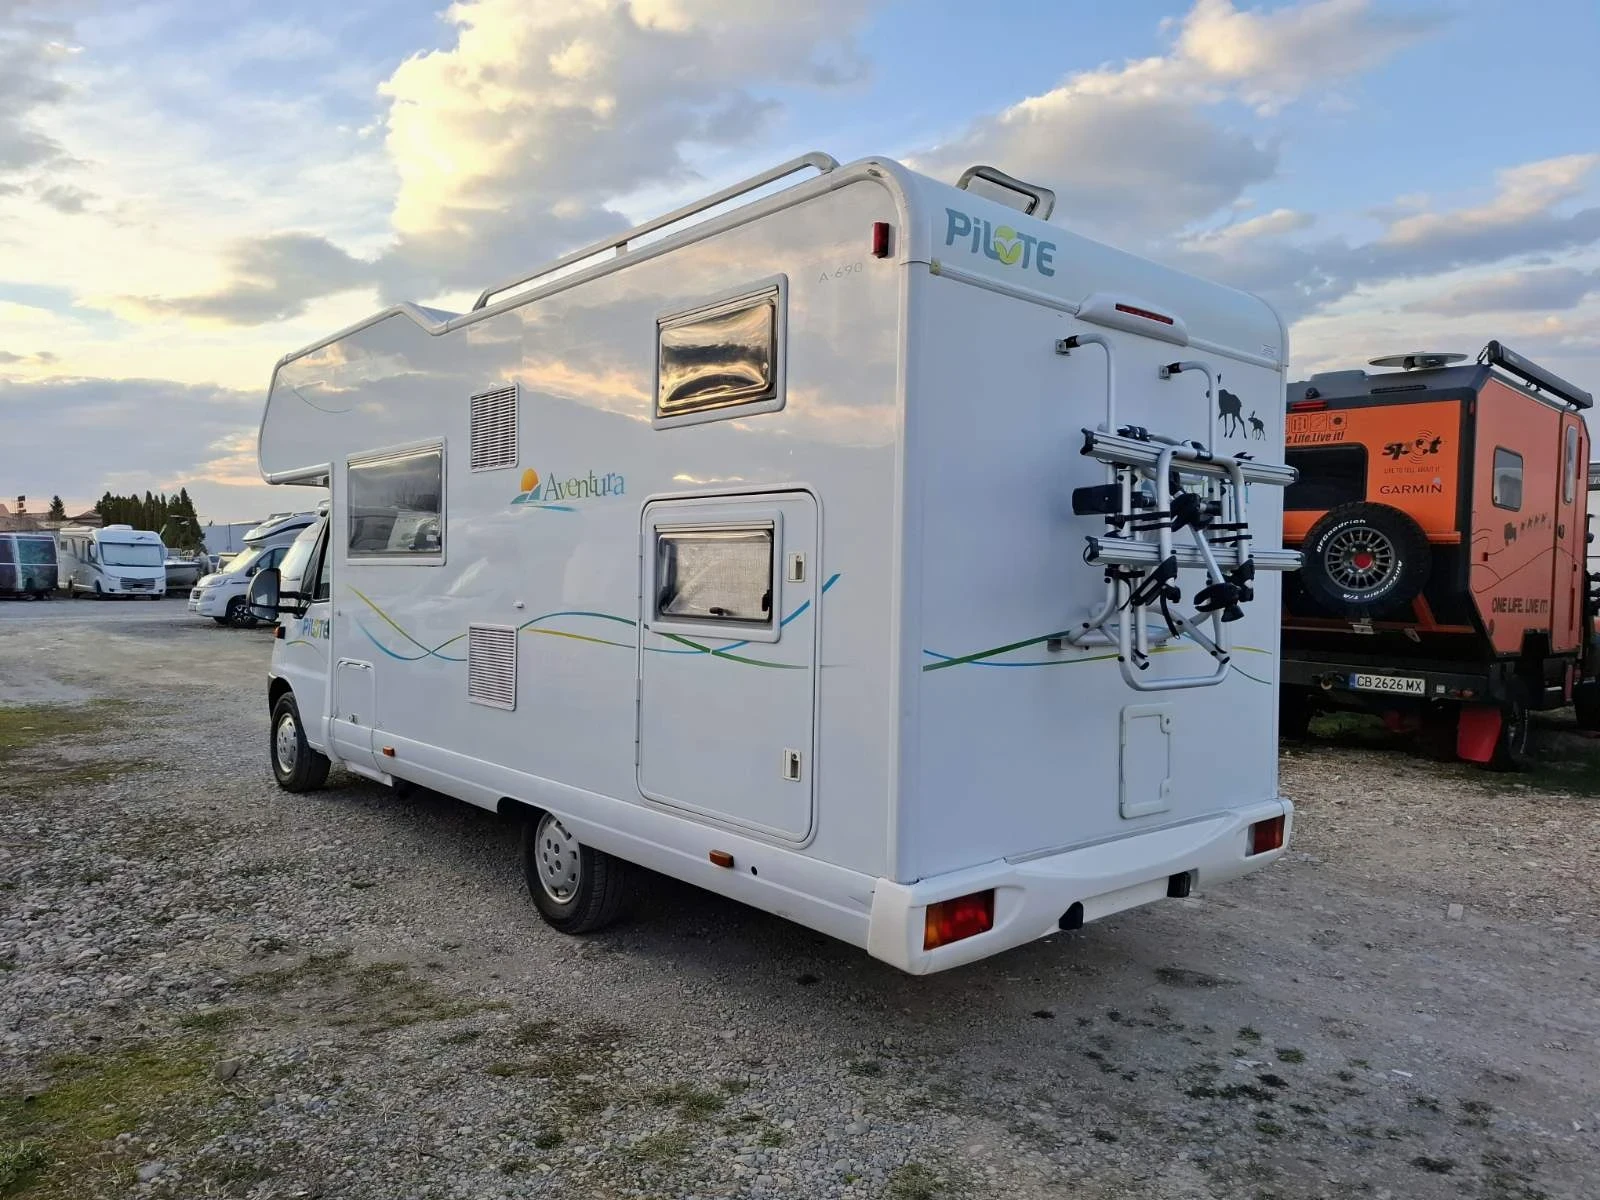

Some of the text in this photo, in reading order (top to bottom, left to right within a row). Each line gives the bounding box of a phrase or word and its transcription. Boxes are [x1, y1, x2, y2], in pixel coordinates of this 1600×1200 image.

[543, 469, 626, 501] Aventura
[1380, 484, 1443, 496] GARMIN
[1316, 519, 1366, 553] BFGoodrich
[1491, 596, 1507, 613] ONE
[1358, 676, 1372, 688] CB
[1374, 677, 1404, 690] 2626
[1406, 679, 1422, 692] MX
